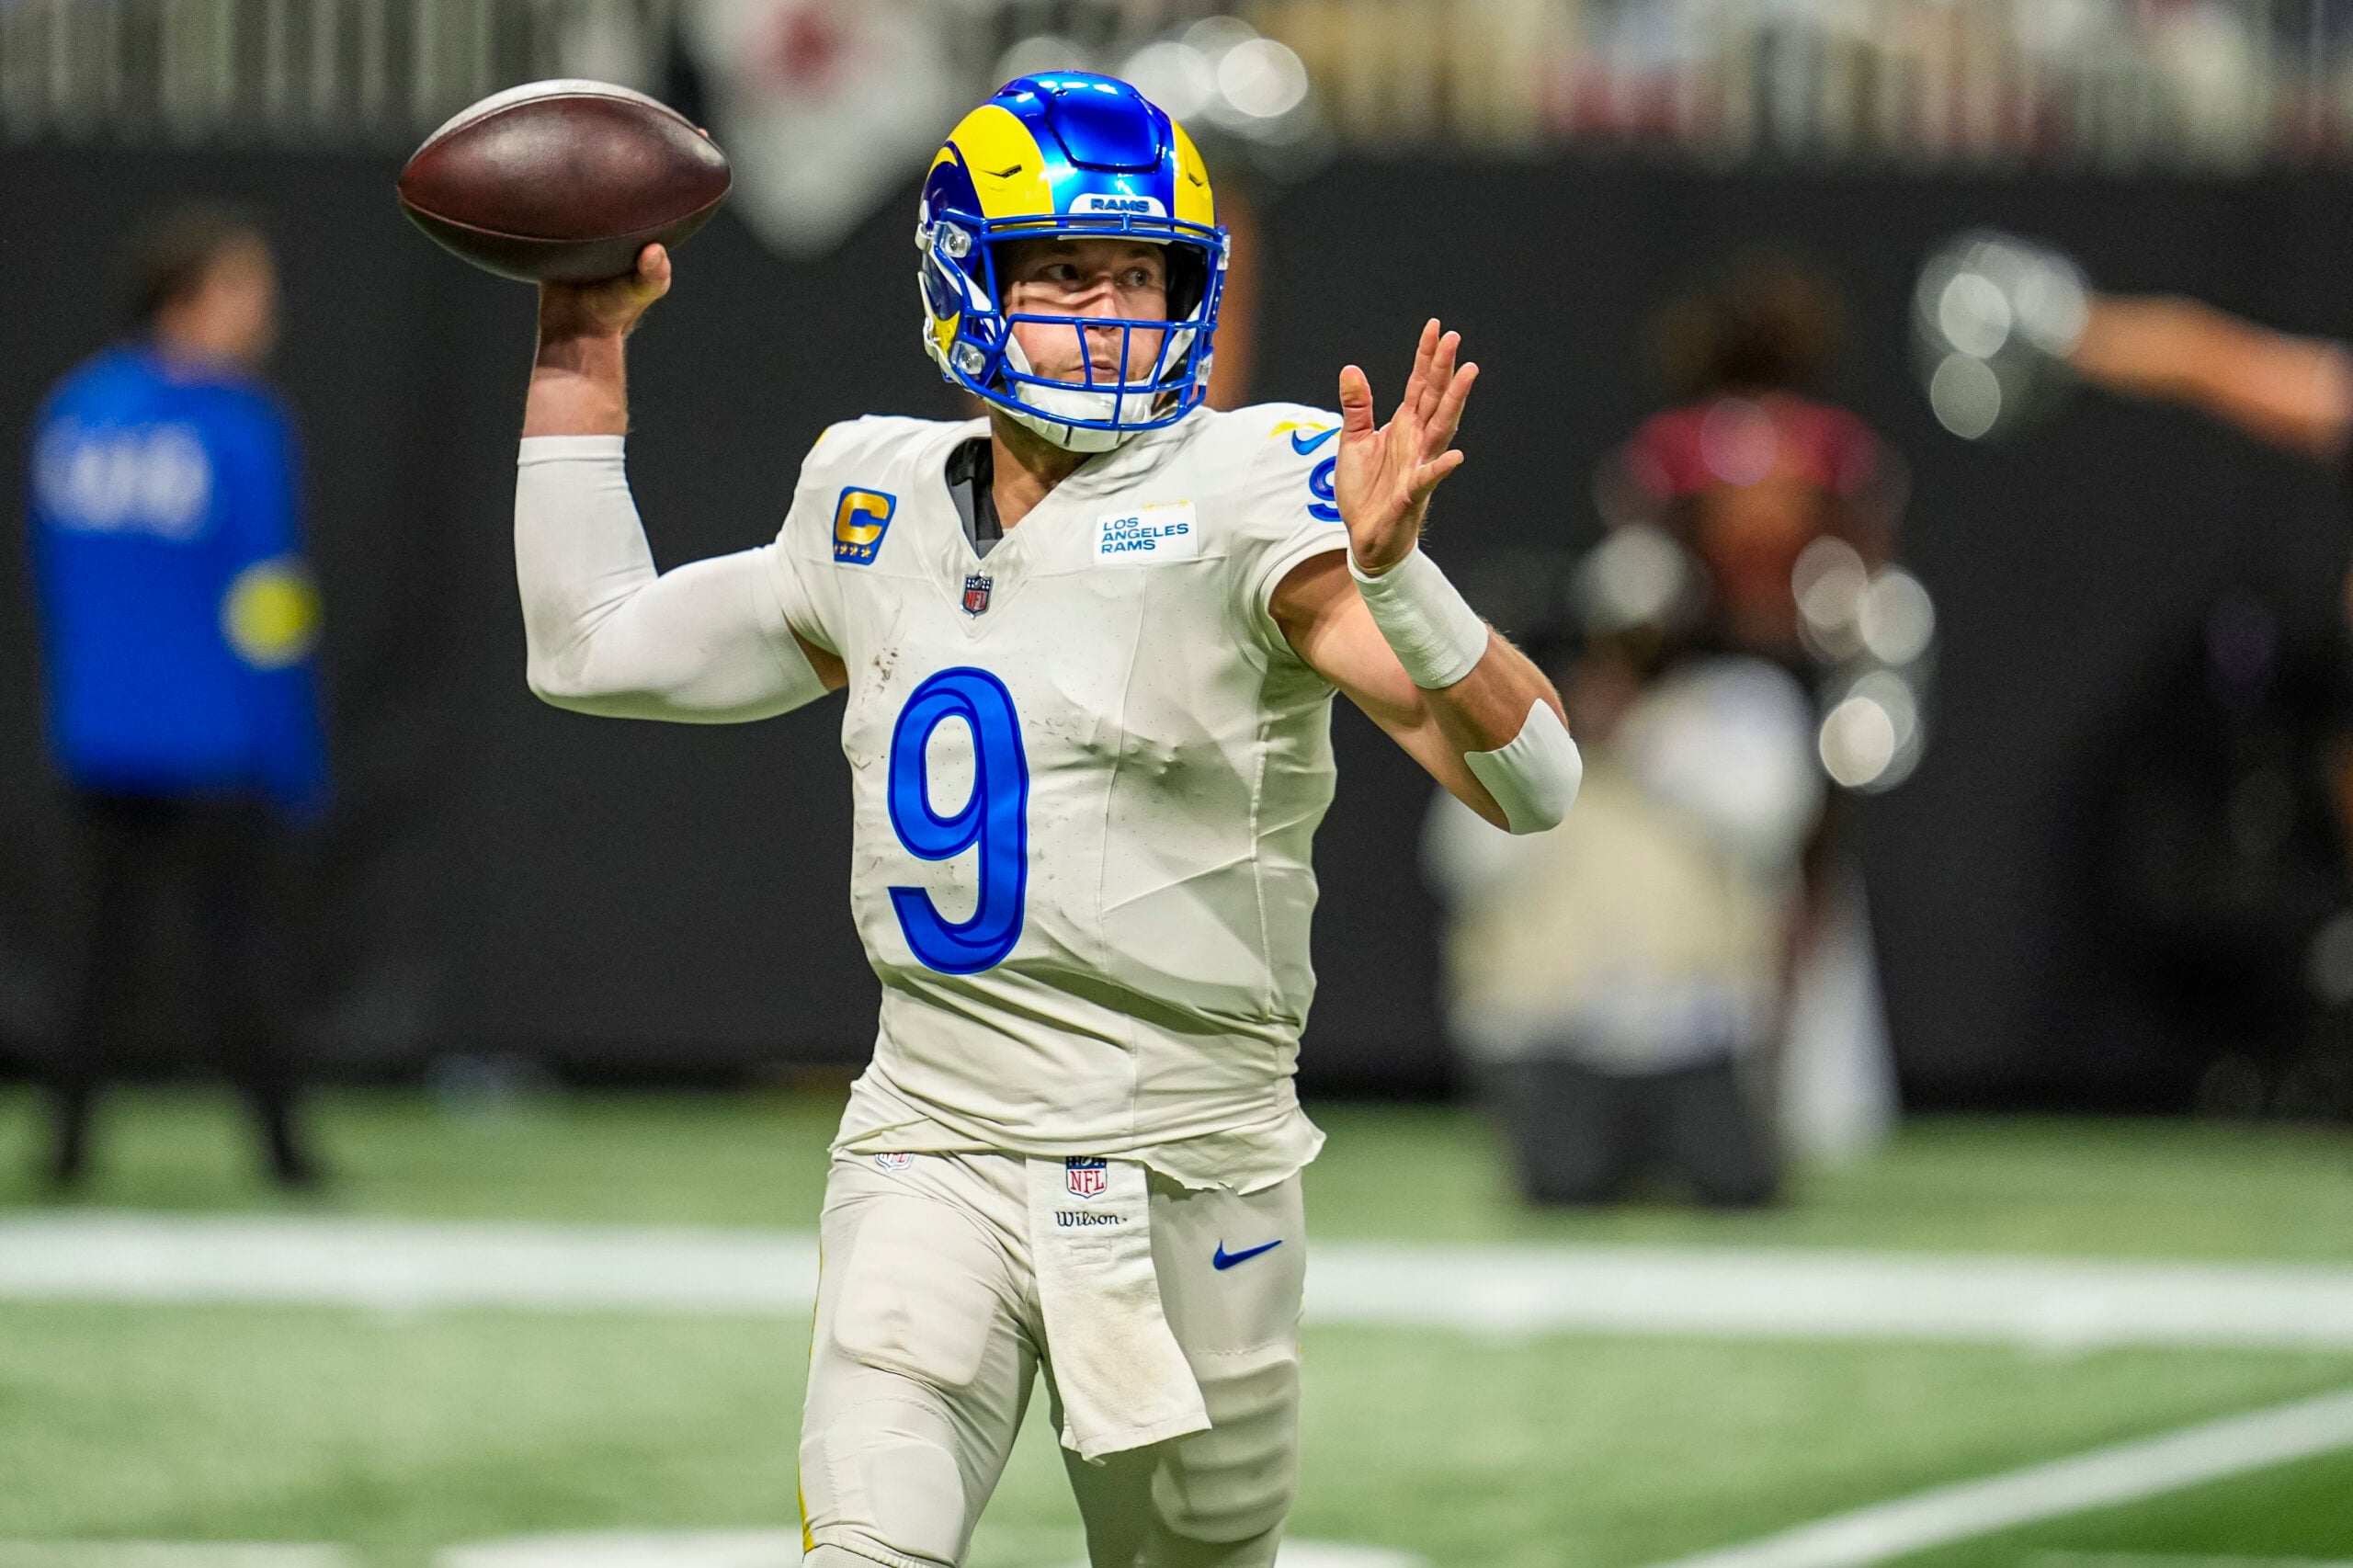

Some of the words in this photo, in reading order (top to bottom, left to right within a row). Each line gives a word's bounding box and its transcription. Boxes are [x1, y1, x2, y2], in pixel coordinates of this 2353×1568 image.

[1091, 198, 1150, 212] RAMS
[835, 491, 889, 545] C
[1103, 517, 1138, 531] LOS
[1102, 523, 1188, 542] ANGELES
[1101, 540, 1155, 553] RAMS
[966, 590, 986, 610] NFL
[887, 666, 1029, 975] 9
[1070, 1170, 1105, 1194] NFL
[1054, 1210, 1120, 1227] Wilson
